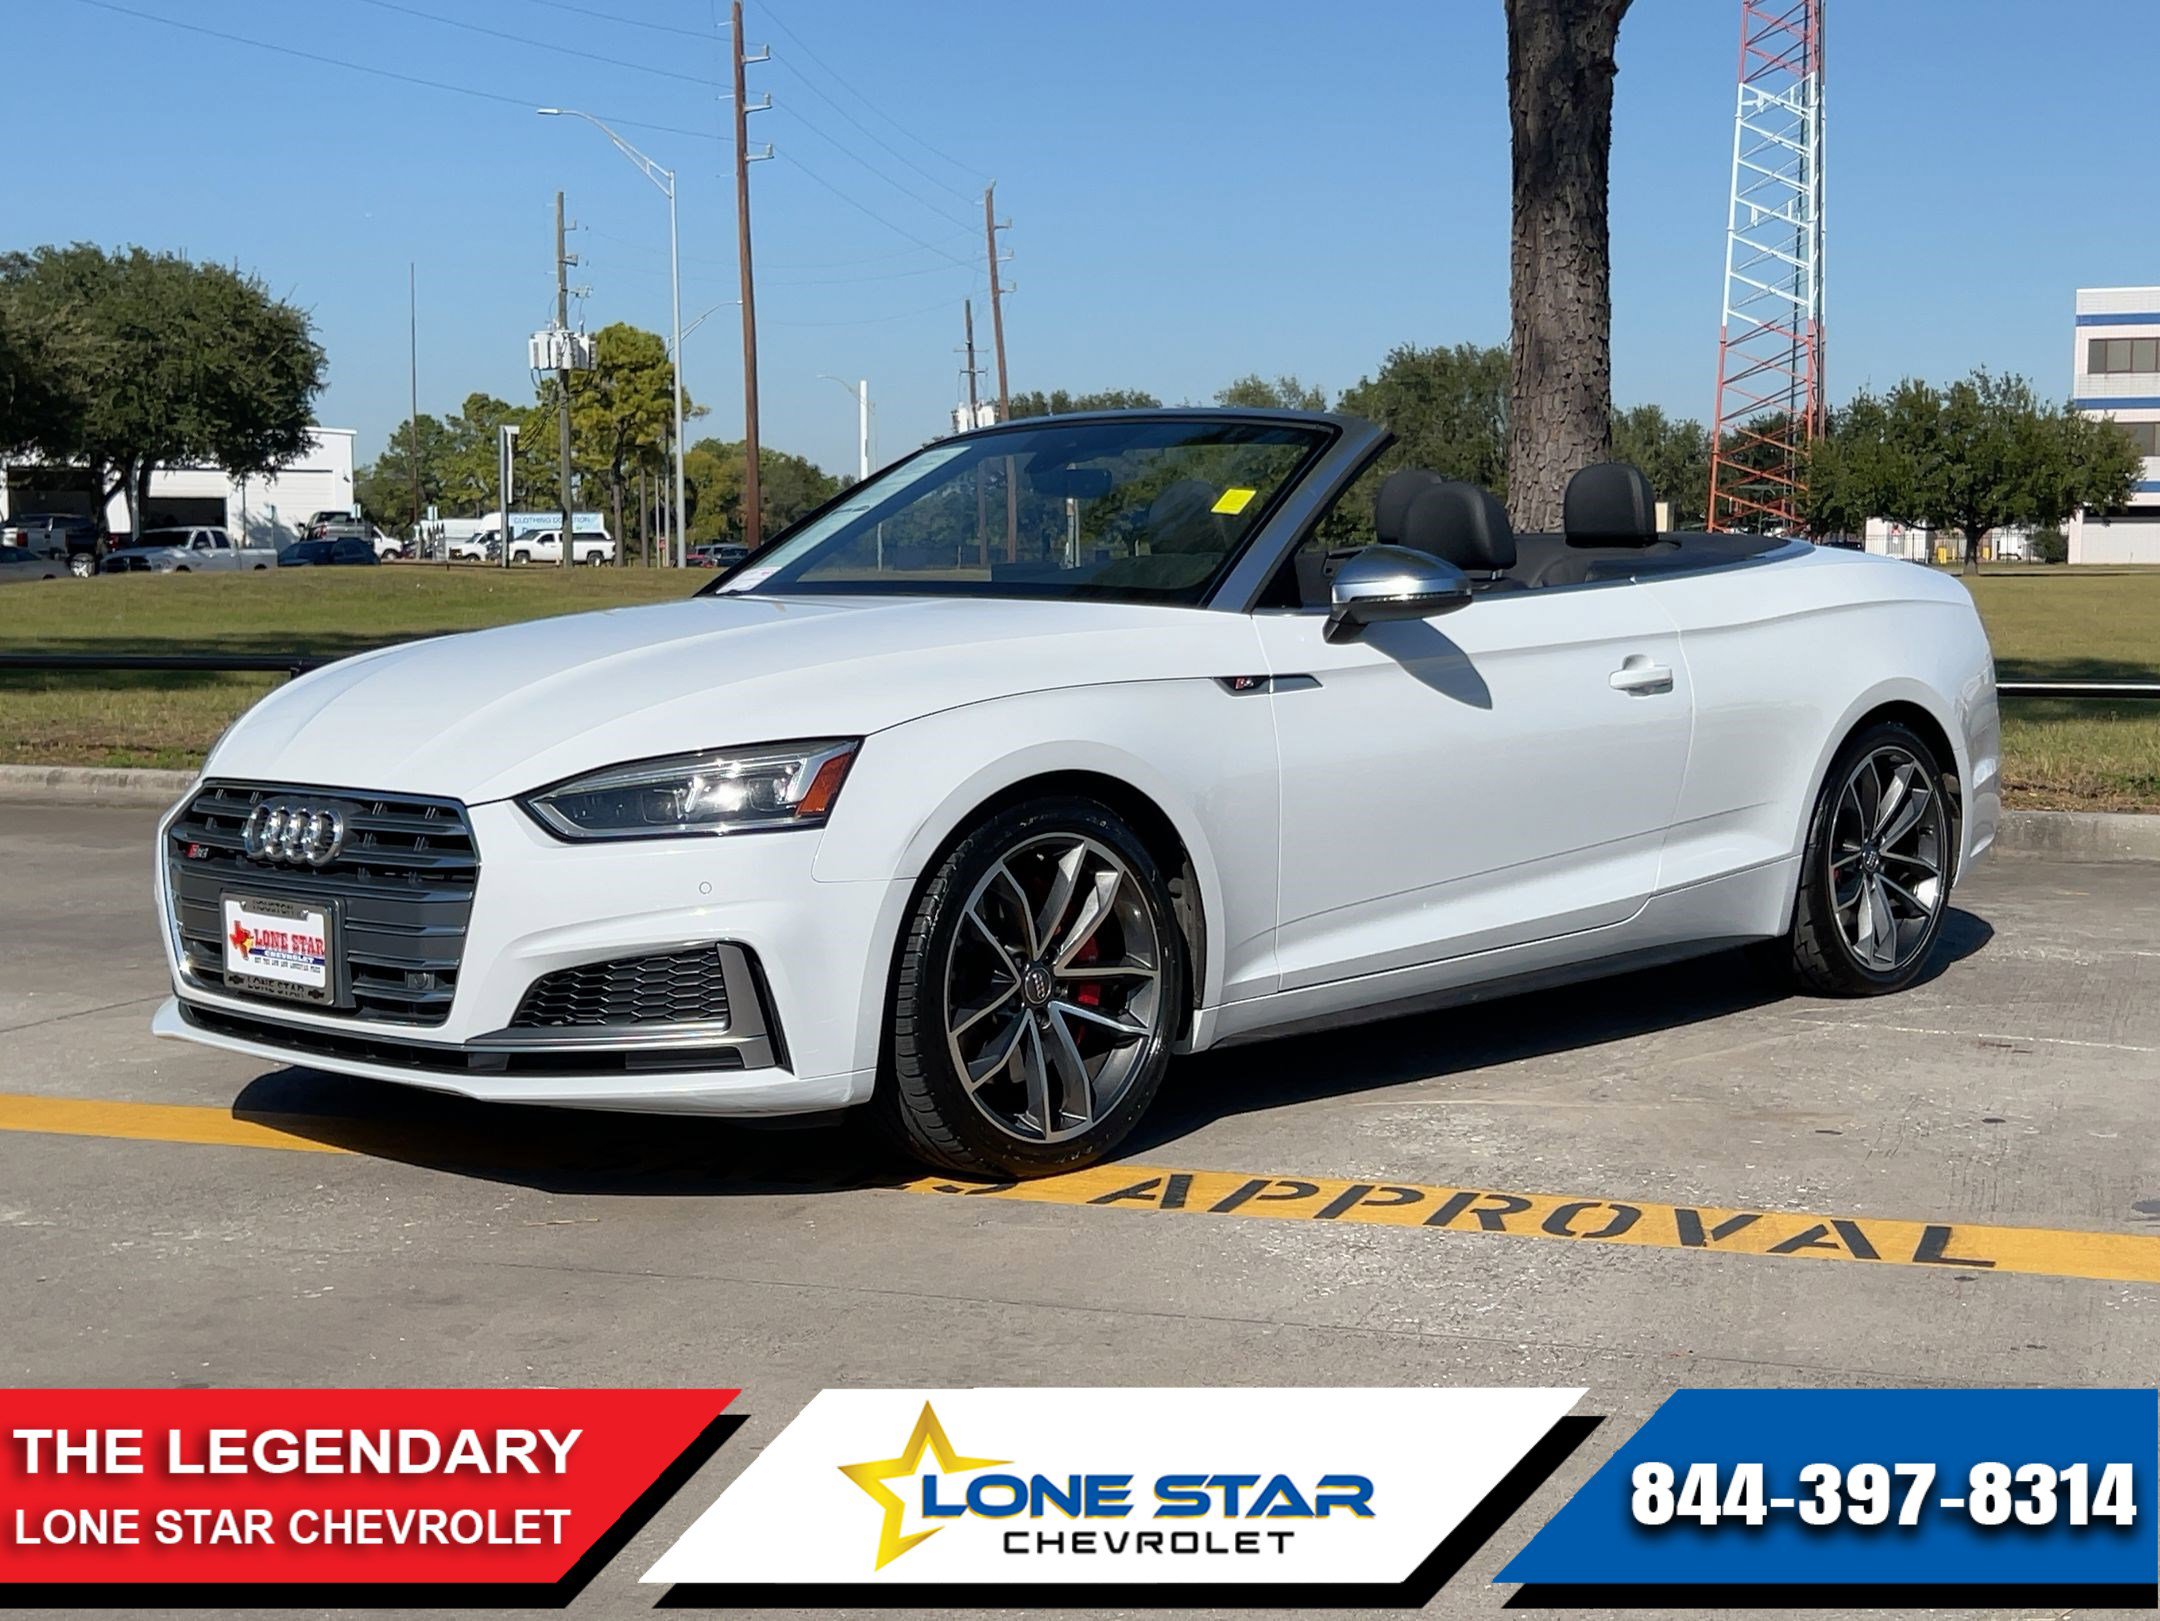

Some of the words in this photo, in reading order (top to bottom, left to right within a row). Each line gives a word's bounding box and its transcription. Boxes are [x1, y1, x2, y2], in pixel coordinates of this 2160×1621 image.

[254, 929, 288, 950] LONE
[291, 934, 325, 955] STAR
[264, 949, 315, 963] CHEVROLET
[1086, 1173, 1996, 1268] APPROVAL
